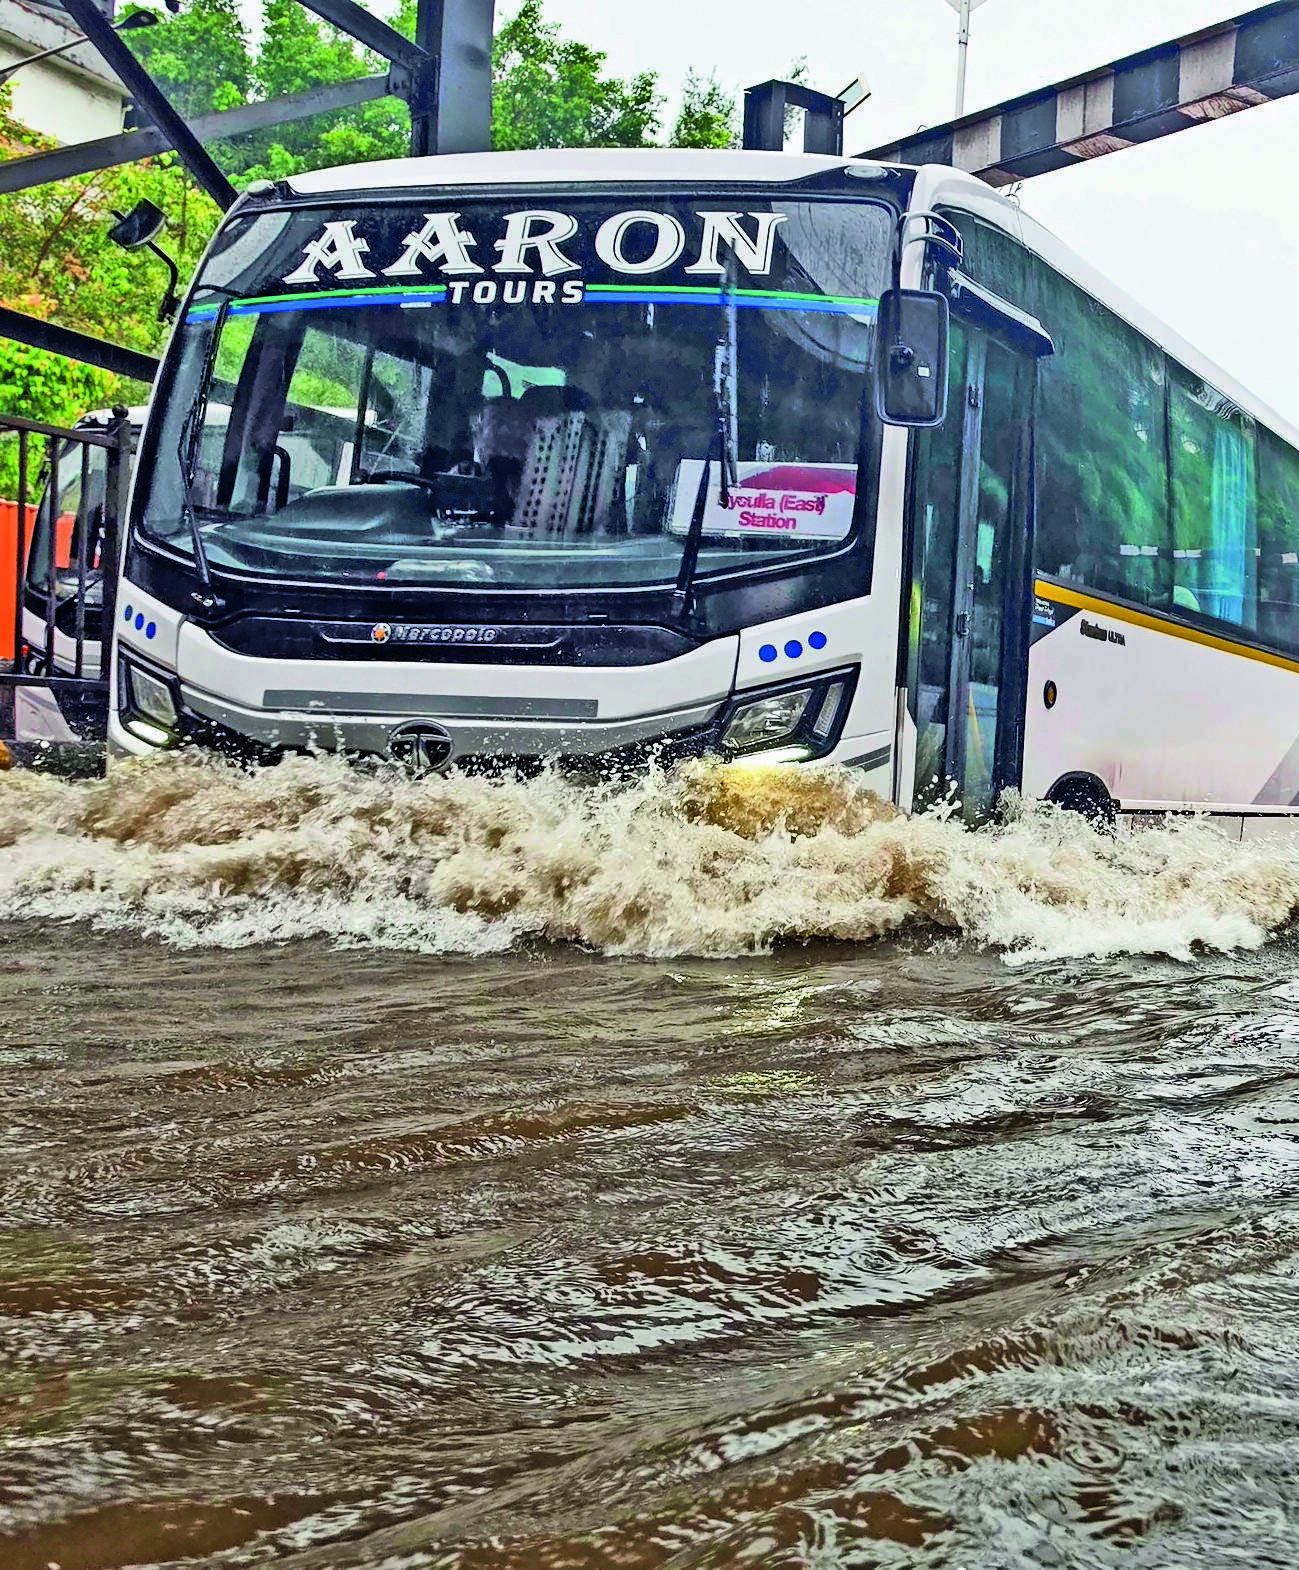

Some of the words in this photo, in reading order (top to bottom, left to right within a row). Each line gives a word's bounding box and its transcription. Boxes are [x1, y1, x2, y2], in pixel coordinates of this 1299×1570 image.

[282, 210, 788, 285] AARON
[447, 280, 585, 305] TOURS
[723, 493, 774, 510] yculla
[739, 511, 797, 529] Station
